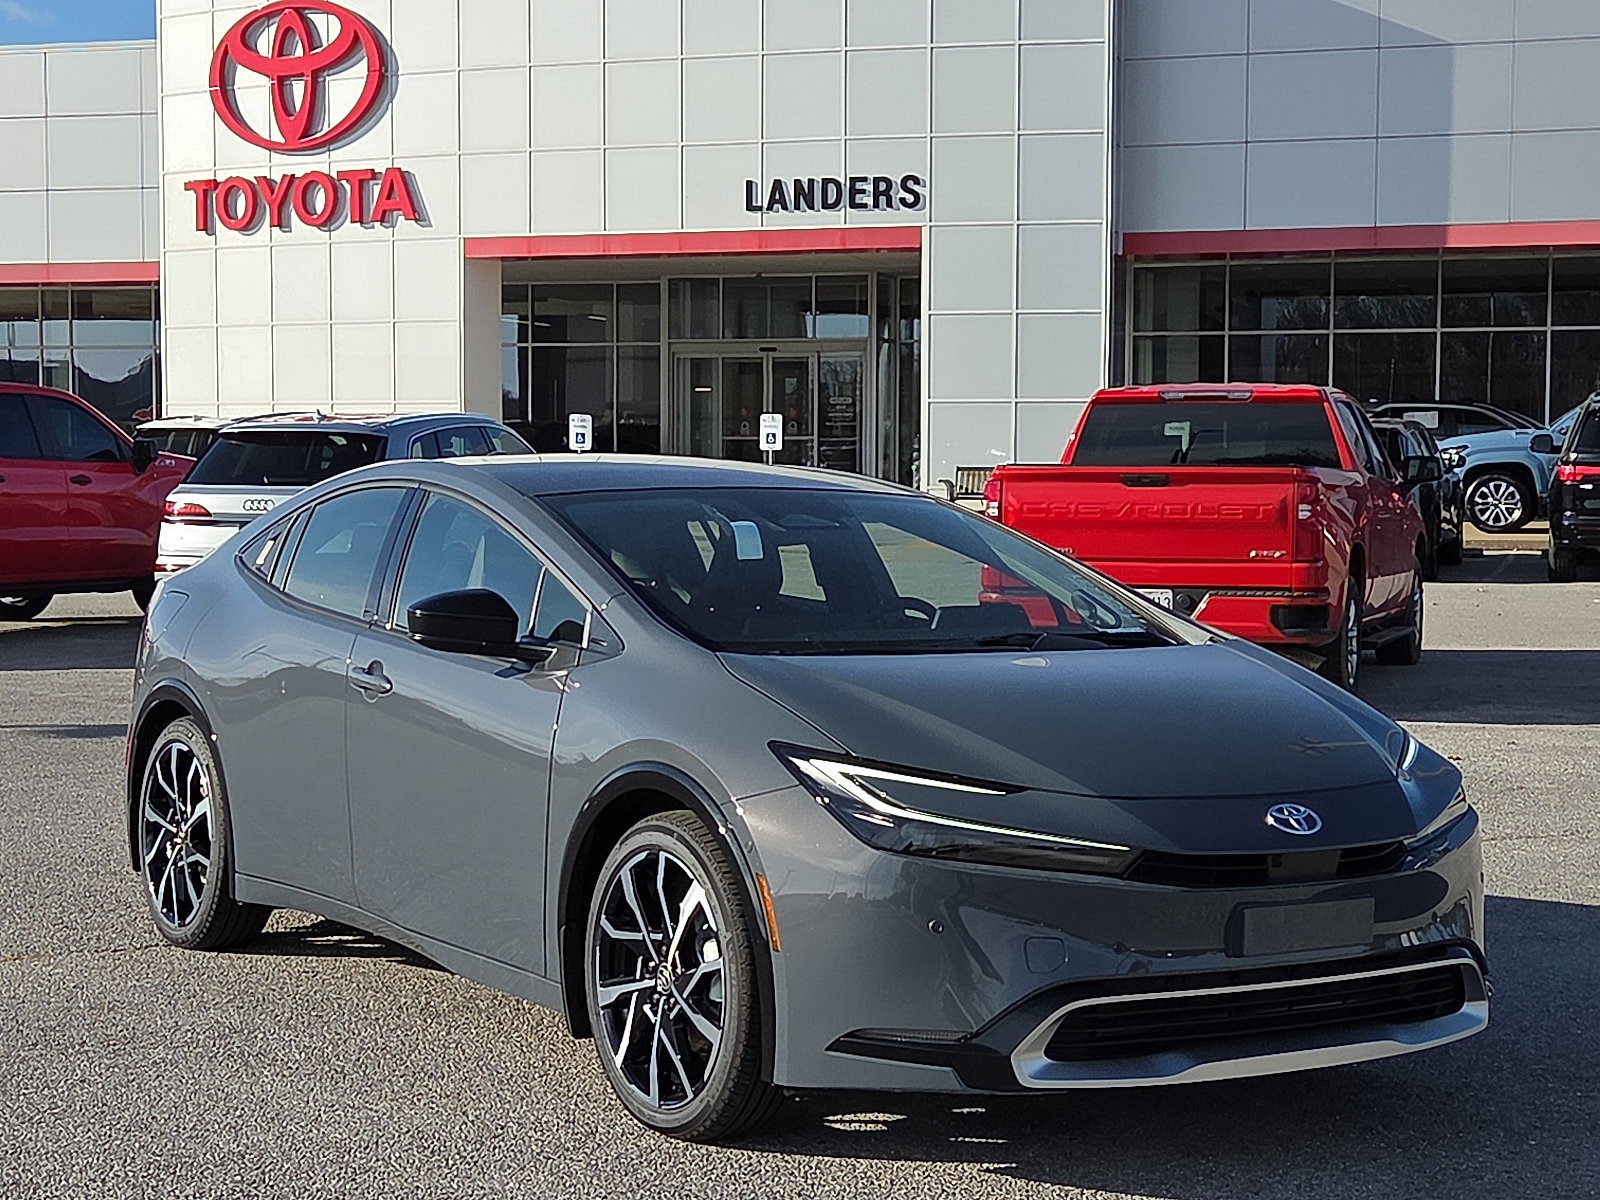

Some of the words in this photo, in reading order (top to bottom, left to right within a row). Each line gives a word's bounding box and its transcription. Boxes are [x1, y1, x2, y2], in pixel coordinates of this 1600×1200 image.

[185, 167, 417, 232] TOYOTA
[745, 174, 922, 212] LANDERS
[1020, 501, 1276, 519] CHEVROLET
